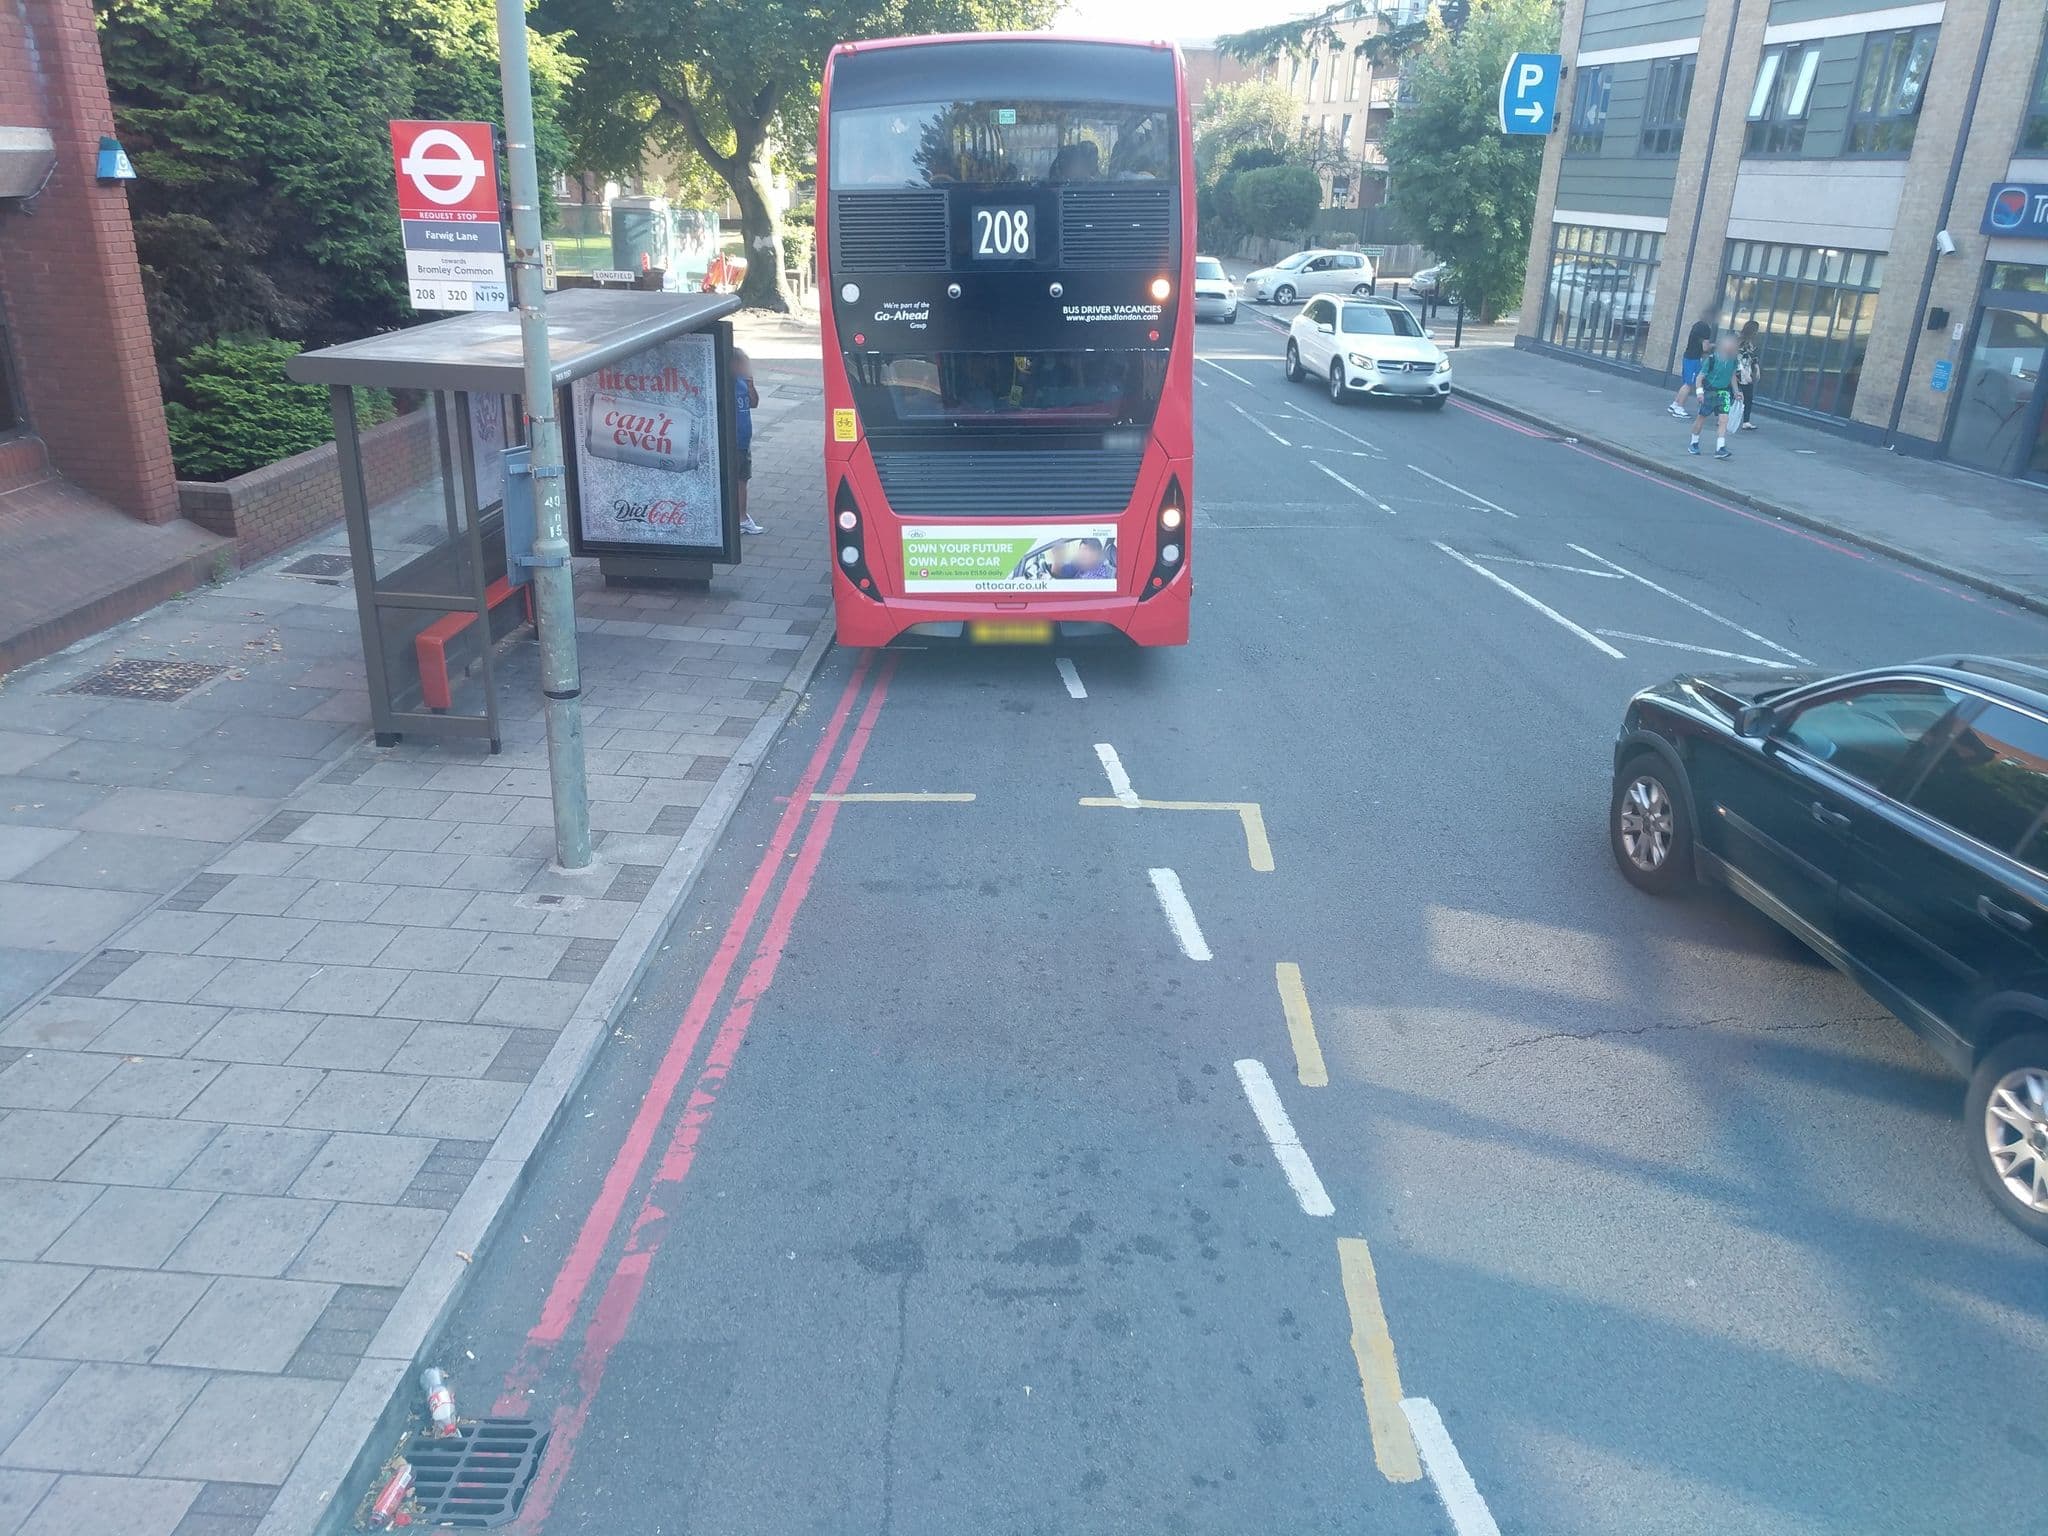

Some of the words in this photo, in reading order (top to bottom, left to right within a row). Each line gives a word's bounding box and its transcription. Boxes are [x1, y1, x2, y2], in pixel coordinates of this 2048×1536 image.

[1517, 64, 1544, 98] P
[2034, 195, 2048, 223] Tr
[419, 212, 454, 220] REQUEST
[457, 213, 478, 221] STOP
[425, 230, 455, 242] Farwig
[456, 232, 479, 241] Lane
[978, 210, 1029, 254] 208
[417, 264, 452, 276] Bromley
[454, 266, 494, 275] Common
[594, 272, 634, 280] LONGFIELD
[416, 289, 436, 300] 208
[447, 290, 468, 301] 320
[475, 291, 505, 302] N199
[1062, 305, 1080, 314] BUS
[1081, 305, 1112, 314] DRIVER
[1113, 304, 1162, 314] VACANCIES
[874, 310, 930, 321] Go-Ahead
[1066, 313, 1159, 322] www.goaheadlondon.com
[604, 410, 674, 437] can't
[613, 429, 673, 455] even
[614, 500, 649, 523] Diet
[646, 500, 688, 526] Coke
[908, 543, 938, 553] OWN
[938, 543, 971, 553] YOUR
[972, 543, 1014, 553] FUTURE
[908, 557, 938, 567] OWN
[940, 557, 949, 567] A
[950, 557, 975, 567] PCO
[976, 557, 1001, 567] CAR
[975, 581, 1048, 591] ottocar.co.uk
